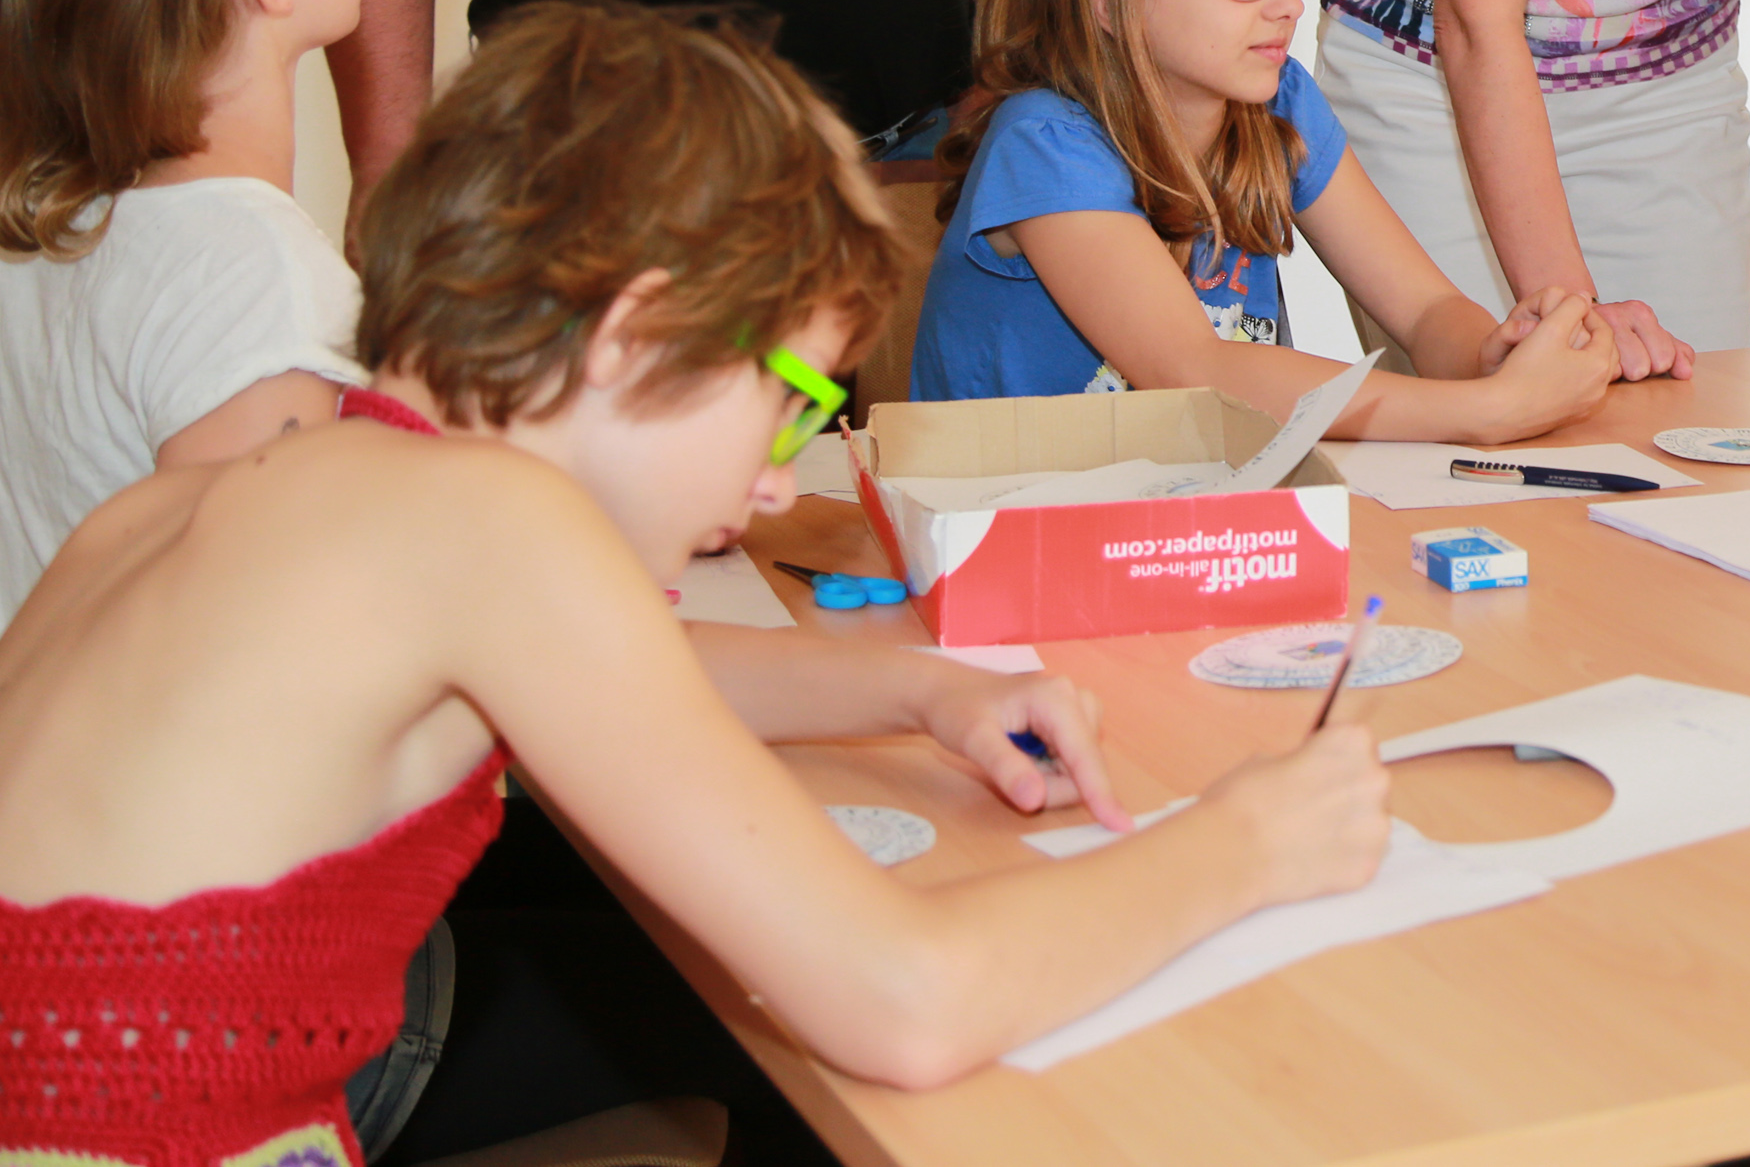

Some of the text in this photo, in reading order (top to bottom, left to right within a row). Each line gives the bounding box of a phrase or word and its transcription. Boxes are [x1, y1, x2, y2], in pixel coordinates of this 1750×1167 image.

[1104, 528, 1298, 560] motifpaper.com
[1130, 553, 1298, 593] motif all-in-one
[1455, 559, 1490, 579] SAX
